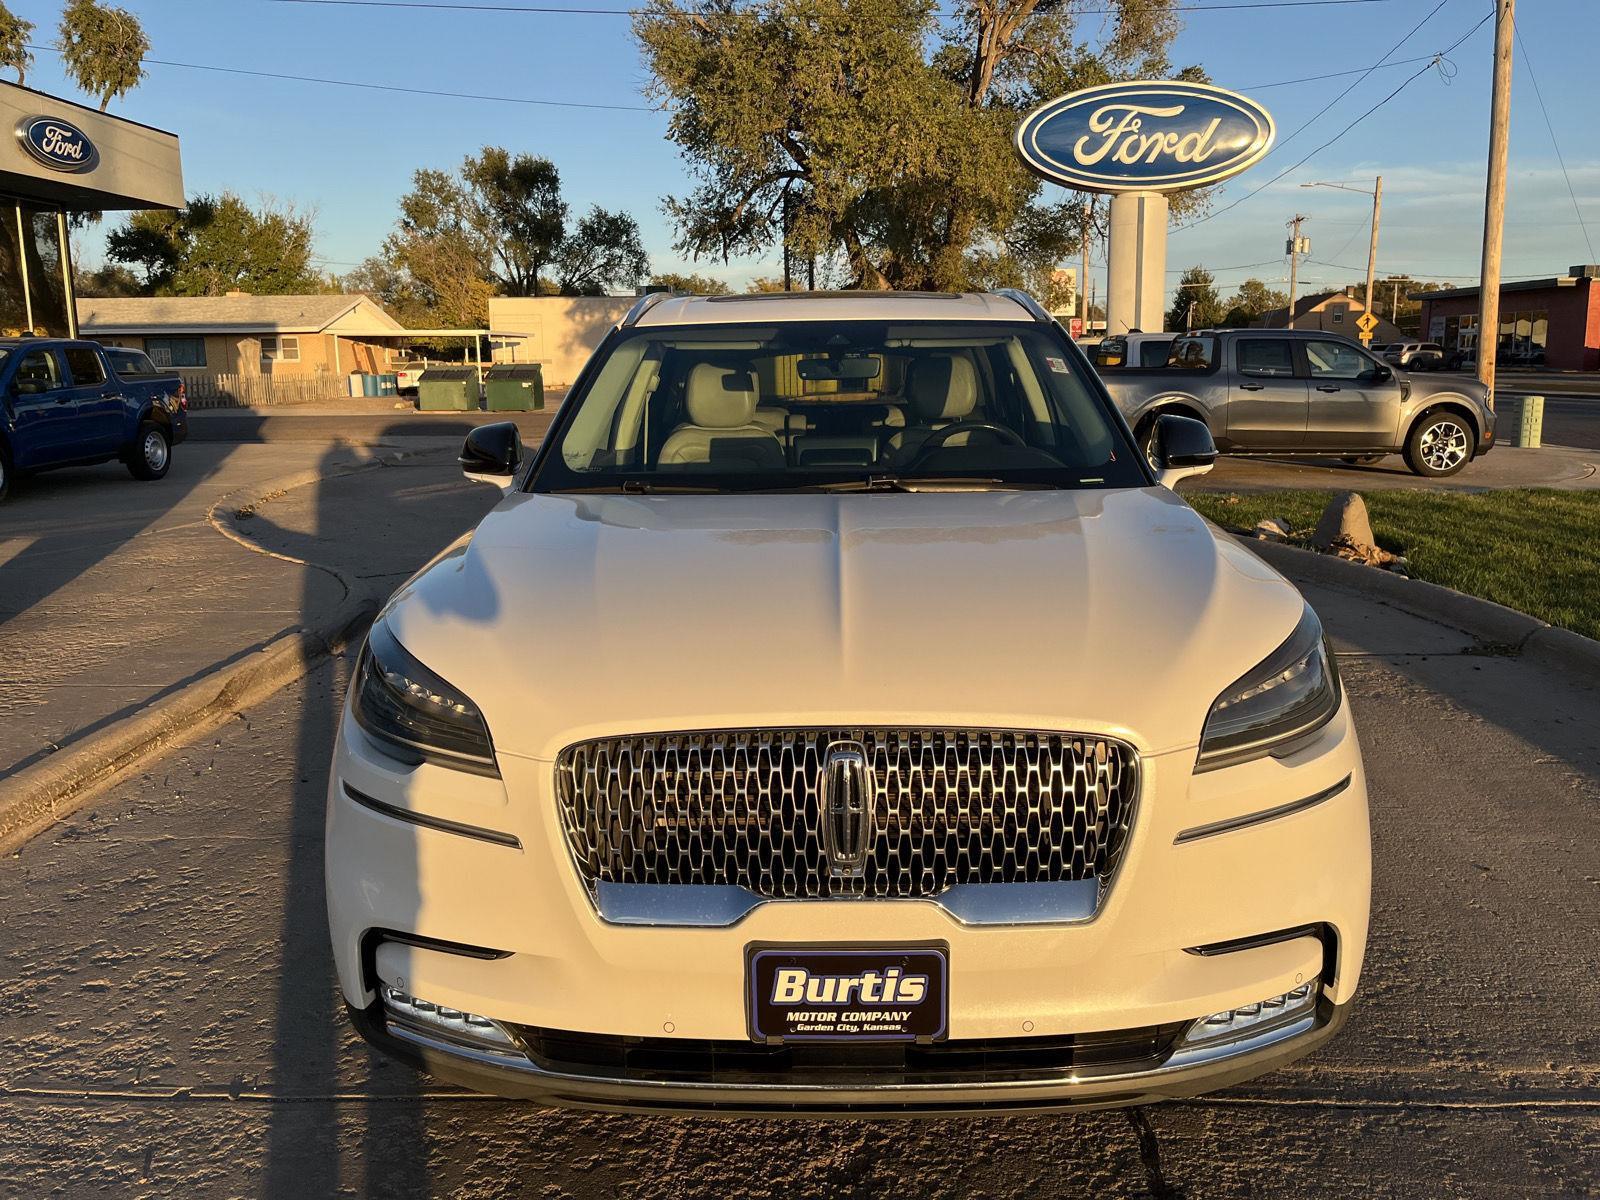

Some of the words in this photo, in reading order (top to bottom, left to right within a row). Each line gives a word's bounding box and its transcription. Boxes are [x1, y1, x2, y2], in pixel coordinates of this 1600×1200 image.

[42, 126, 83, 160] Ford
[1073, 104, 1222, 166] Ford
[773, 969, 926, 1003] Burtis
[786, 1011, 837, 1022] MOTOR
[841, 1011, 912, 1022] COMPANY
[796, 1023, 834, 1031] Garden
[836, 1023, 860, 1033] City,
[863, 1023, 902, 1032] Kansas
